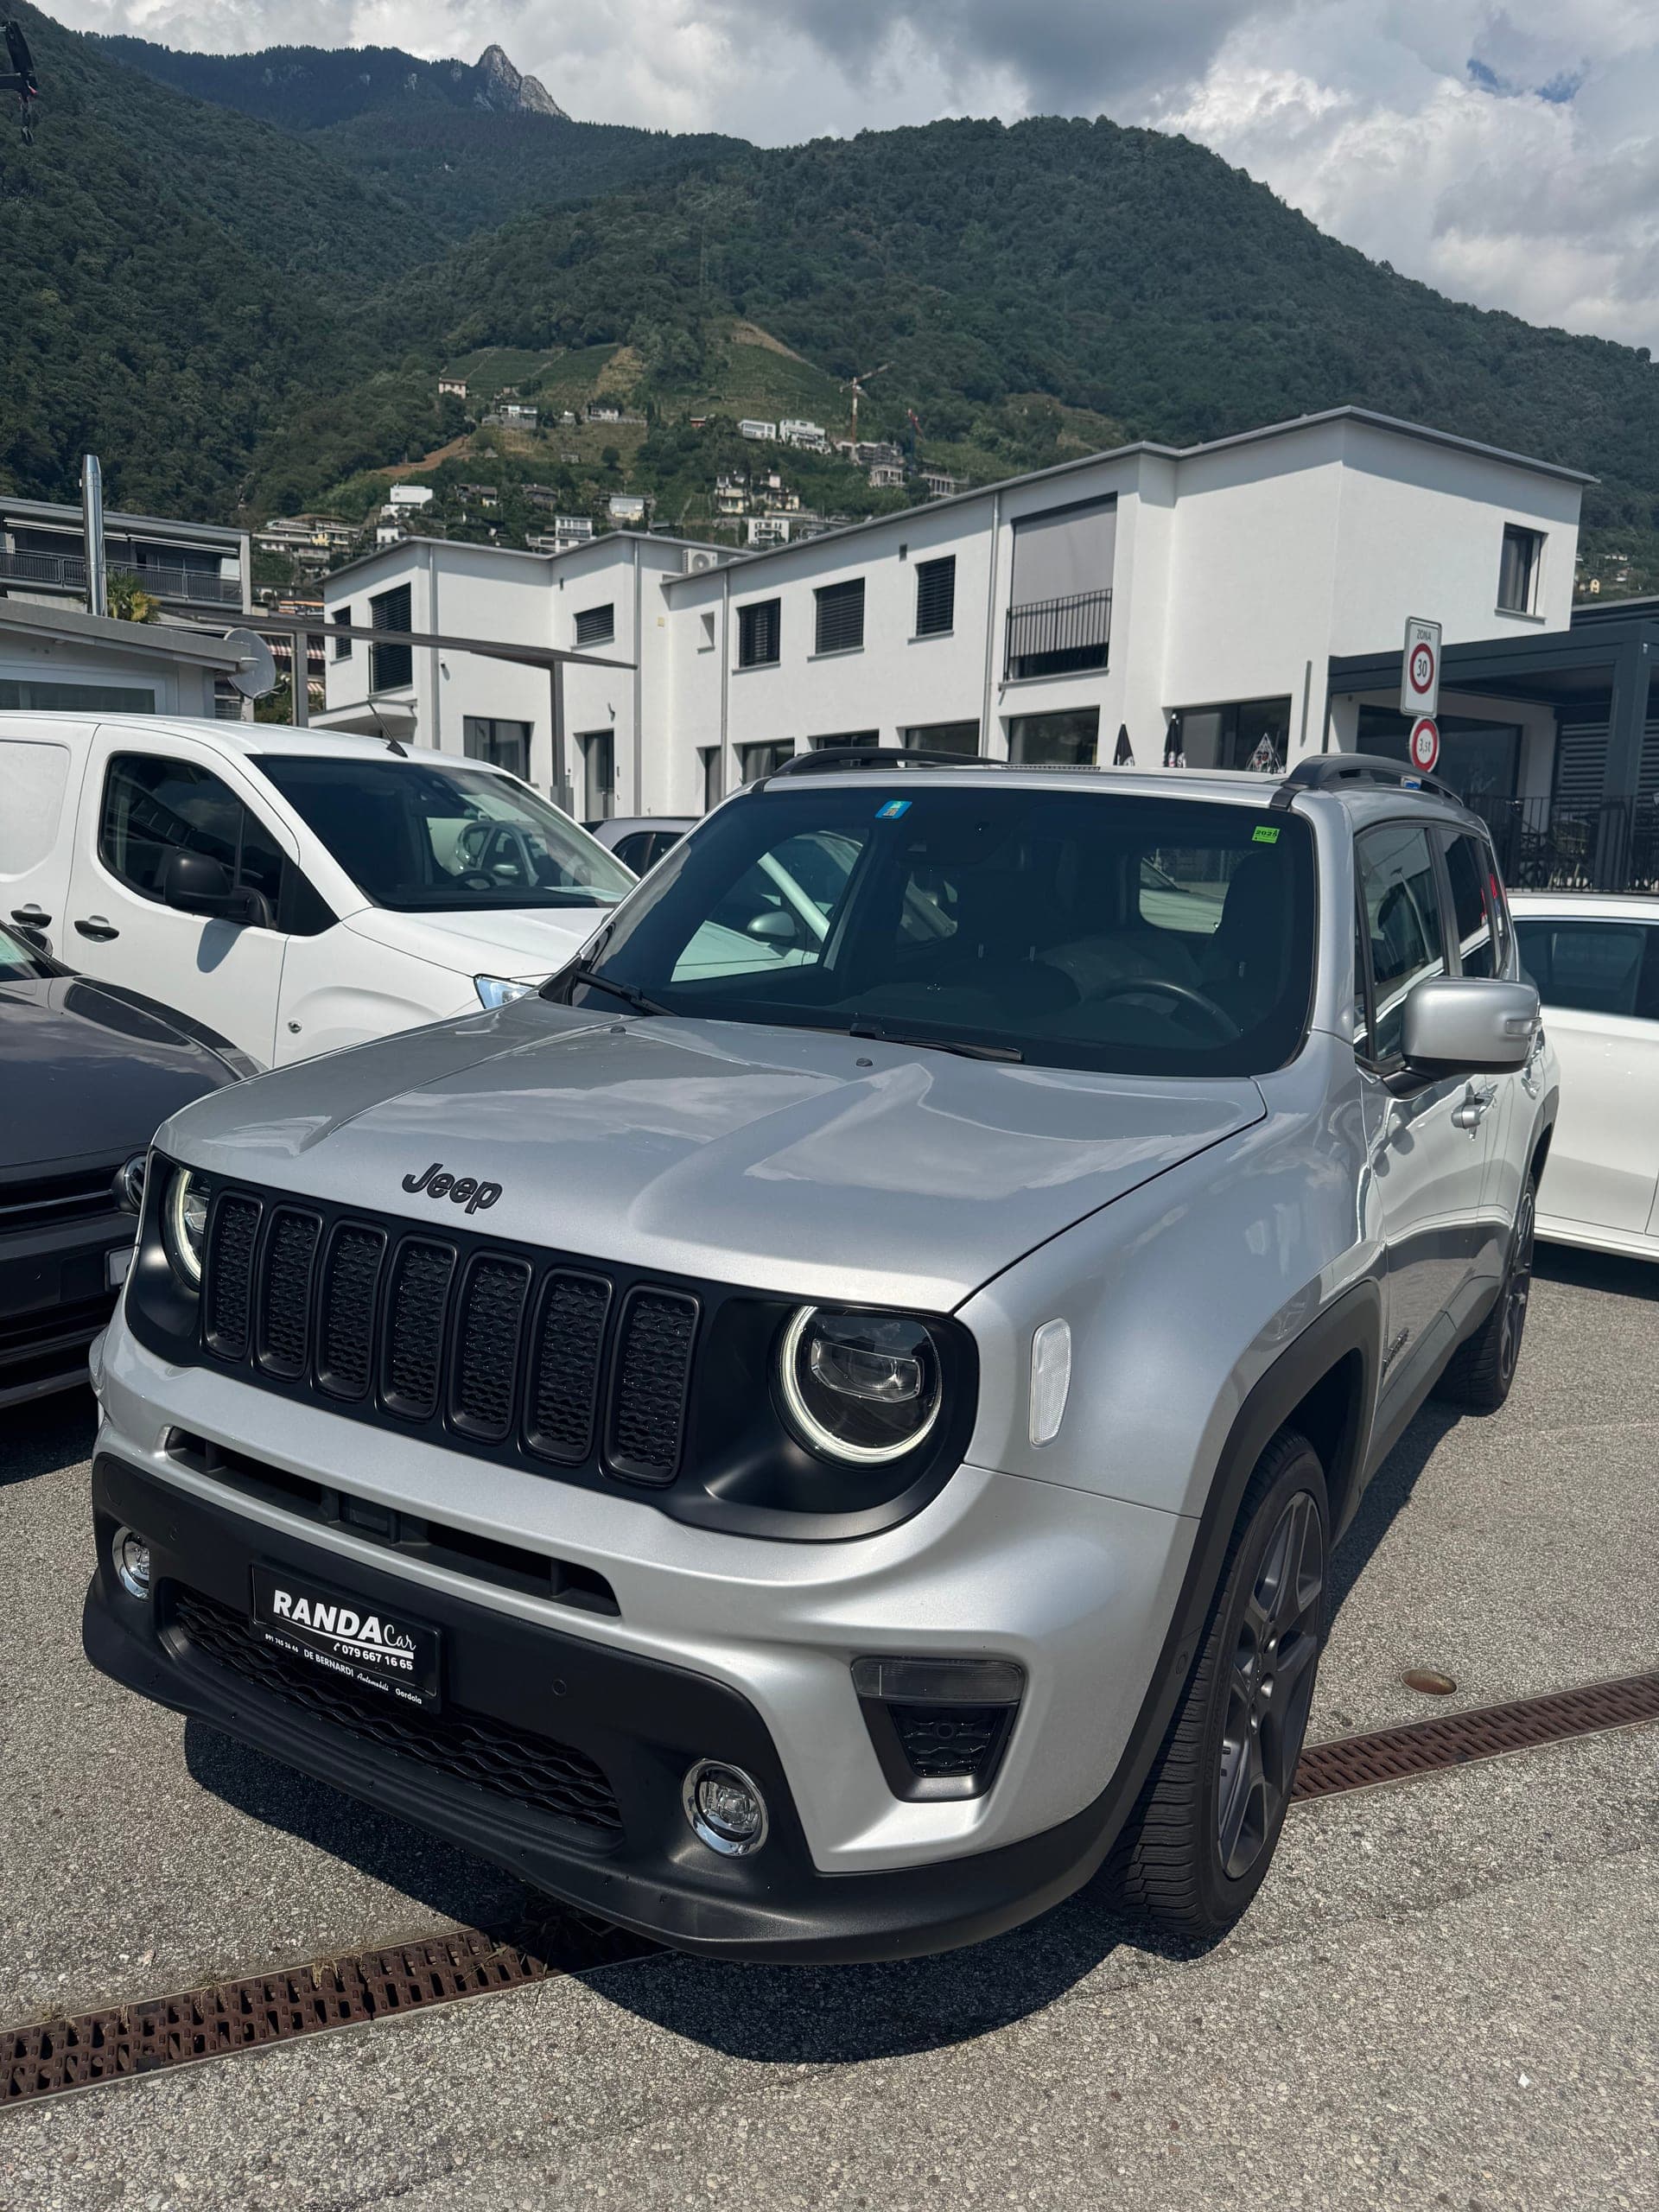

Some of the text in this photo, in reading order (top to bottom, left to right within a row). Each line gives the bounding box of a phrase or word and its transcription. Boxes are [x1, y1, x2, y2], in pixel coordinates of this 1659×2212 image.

[1417, 629, 1432, 640] ZONA
[1417, 659, 1427, 677] 30
[402, 1162, 503, 1215] Jeep
[273, 1589, 416, 1651] RANDA Car
[341, 1644, 414, 1670] 079 667 16 65
[303, 1649, 315, 1660] DE
[315, 1654, 354, 1677] BERNARDI
[395, 1688, 423, 1705] Gordola
